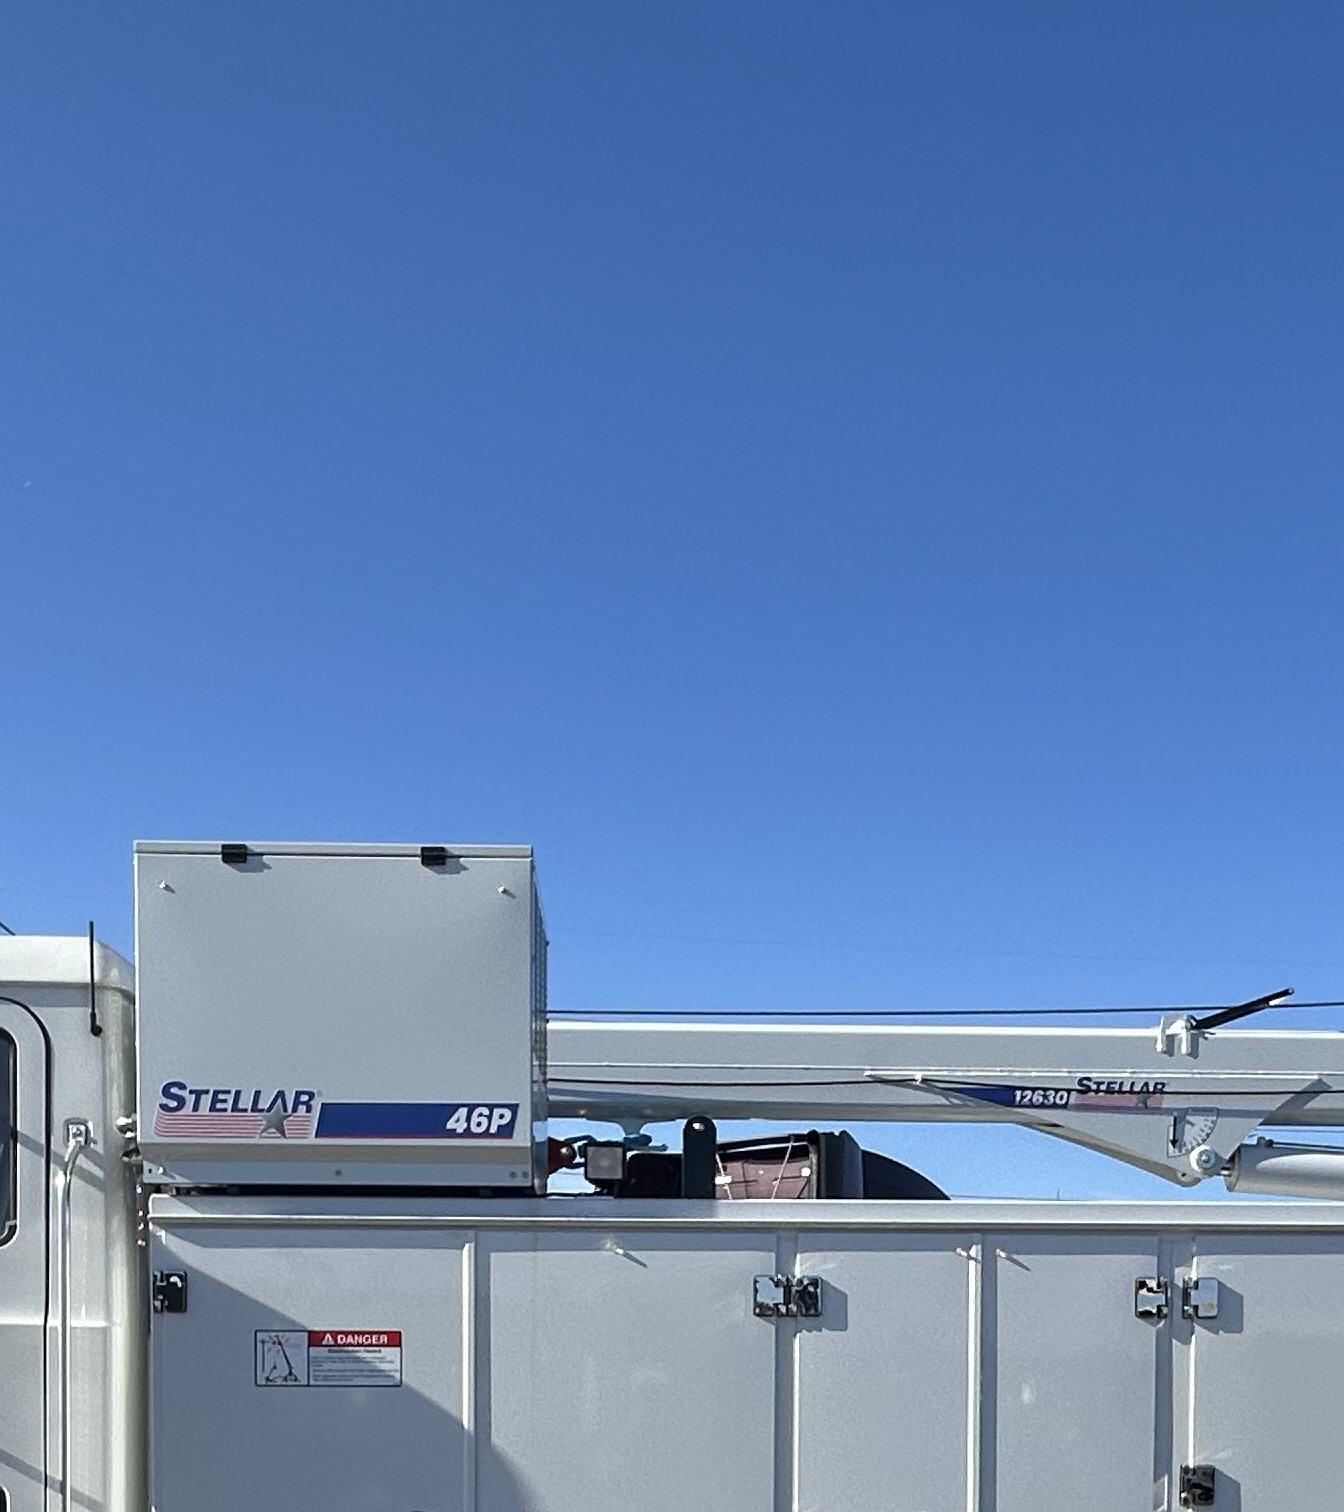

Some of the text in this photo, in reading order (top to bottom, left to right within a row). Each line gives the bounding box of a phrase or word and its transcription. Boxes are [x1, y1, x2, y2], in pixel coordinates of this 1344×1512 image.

[158, 1081, 316, 1115] STELLAR
[1013, 1076, 1167, 1106] 12630 STELLAR
[445, 1106, 513, 1135] 46P
[337, 1334, 388, 1345] DANGER
